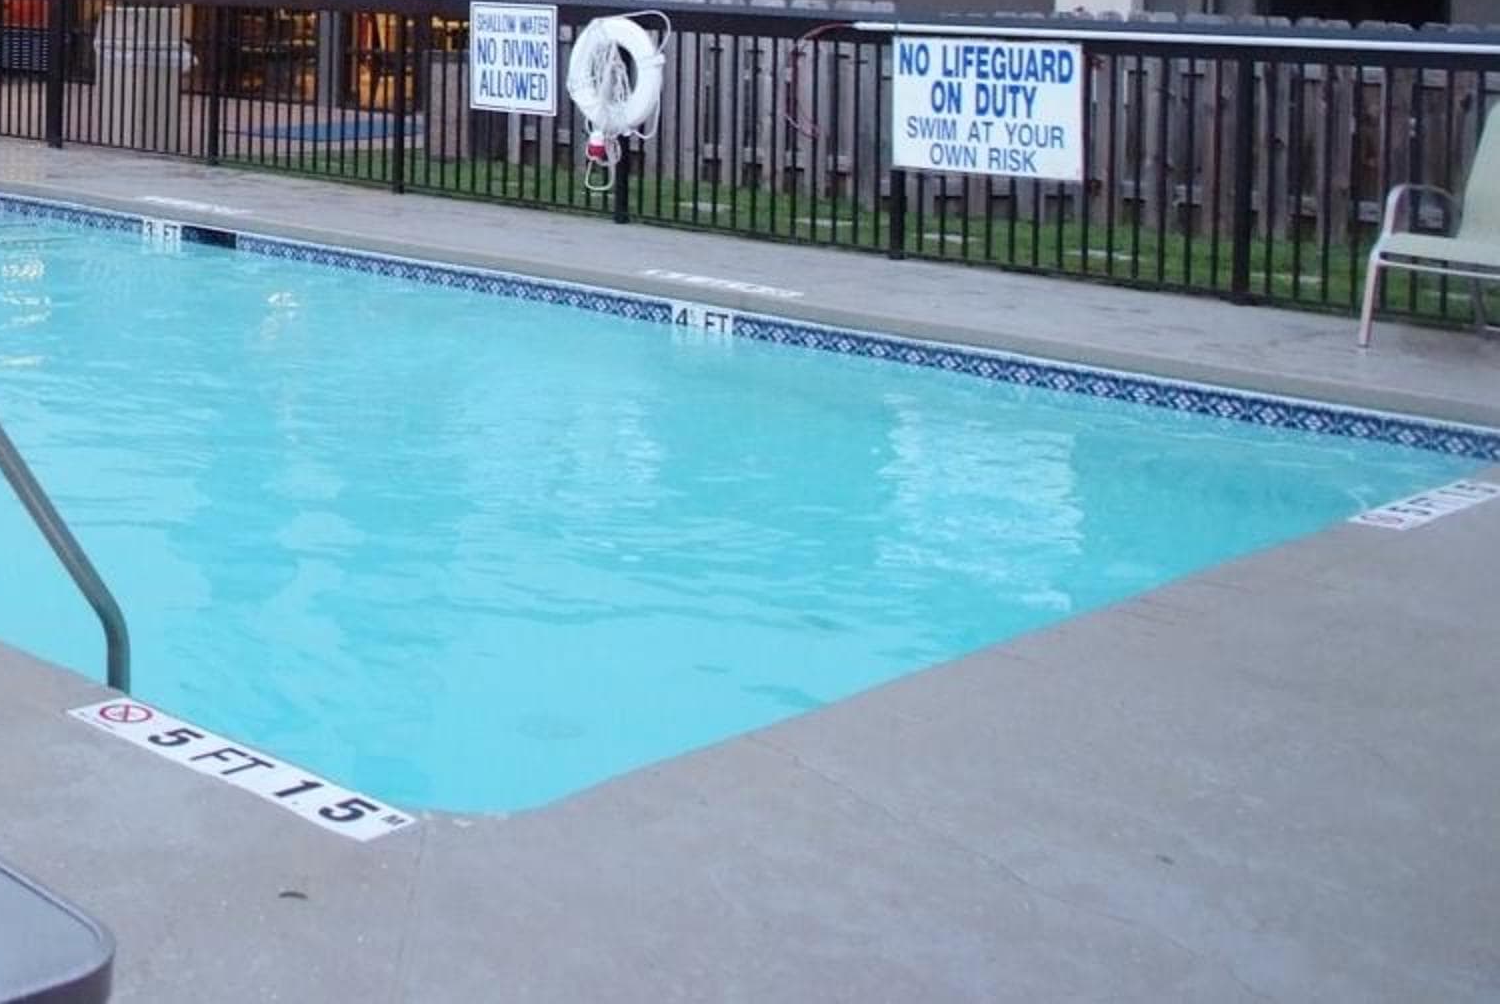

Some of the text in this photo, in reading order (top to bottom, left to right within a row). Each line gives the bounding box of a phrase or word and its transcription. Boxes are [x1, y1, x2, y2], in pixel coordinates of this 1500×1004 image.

[477, 13, 549, 35] SHALLOW WATER
[477, 37, 549, 69] NO DIVING
[900, 43, 1074, 84] NO LIFEGUARD
[480, 69, 548, 101] ALLOWED
[931, 81, 1037, 118] ON DUTY
[907, 116, 1065, 148] SWIM AT YOUR
[930, 143, 1037, 173] OWN RISK
[675, 308, 729, 332] 4 FT
[148, 728, 204, 747] 5
[189, 747, 275, 776] FT
